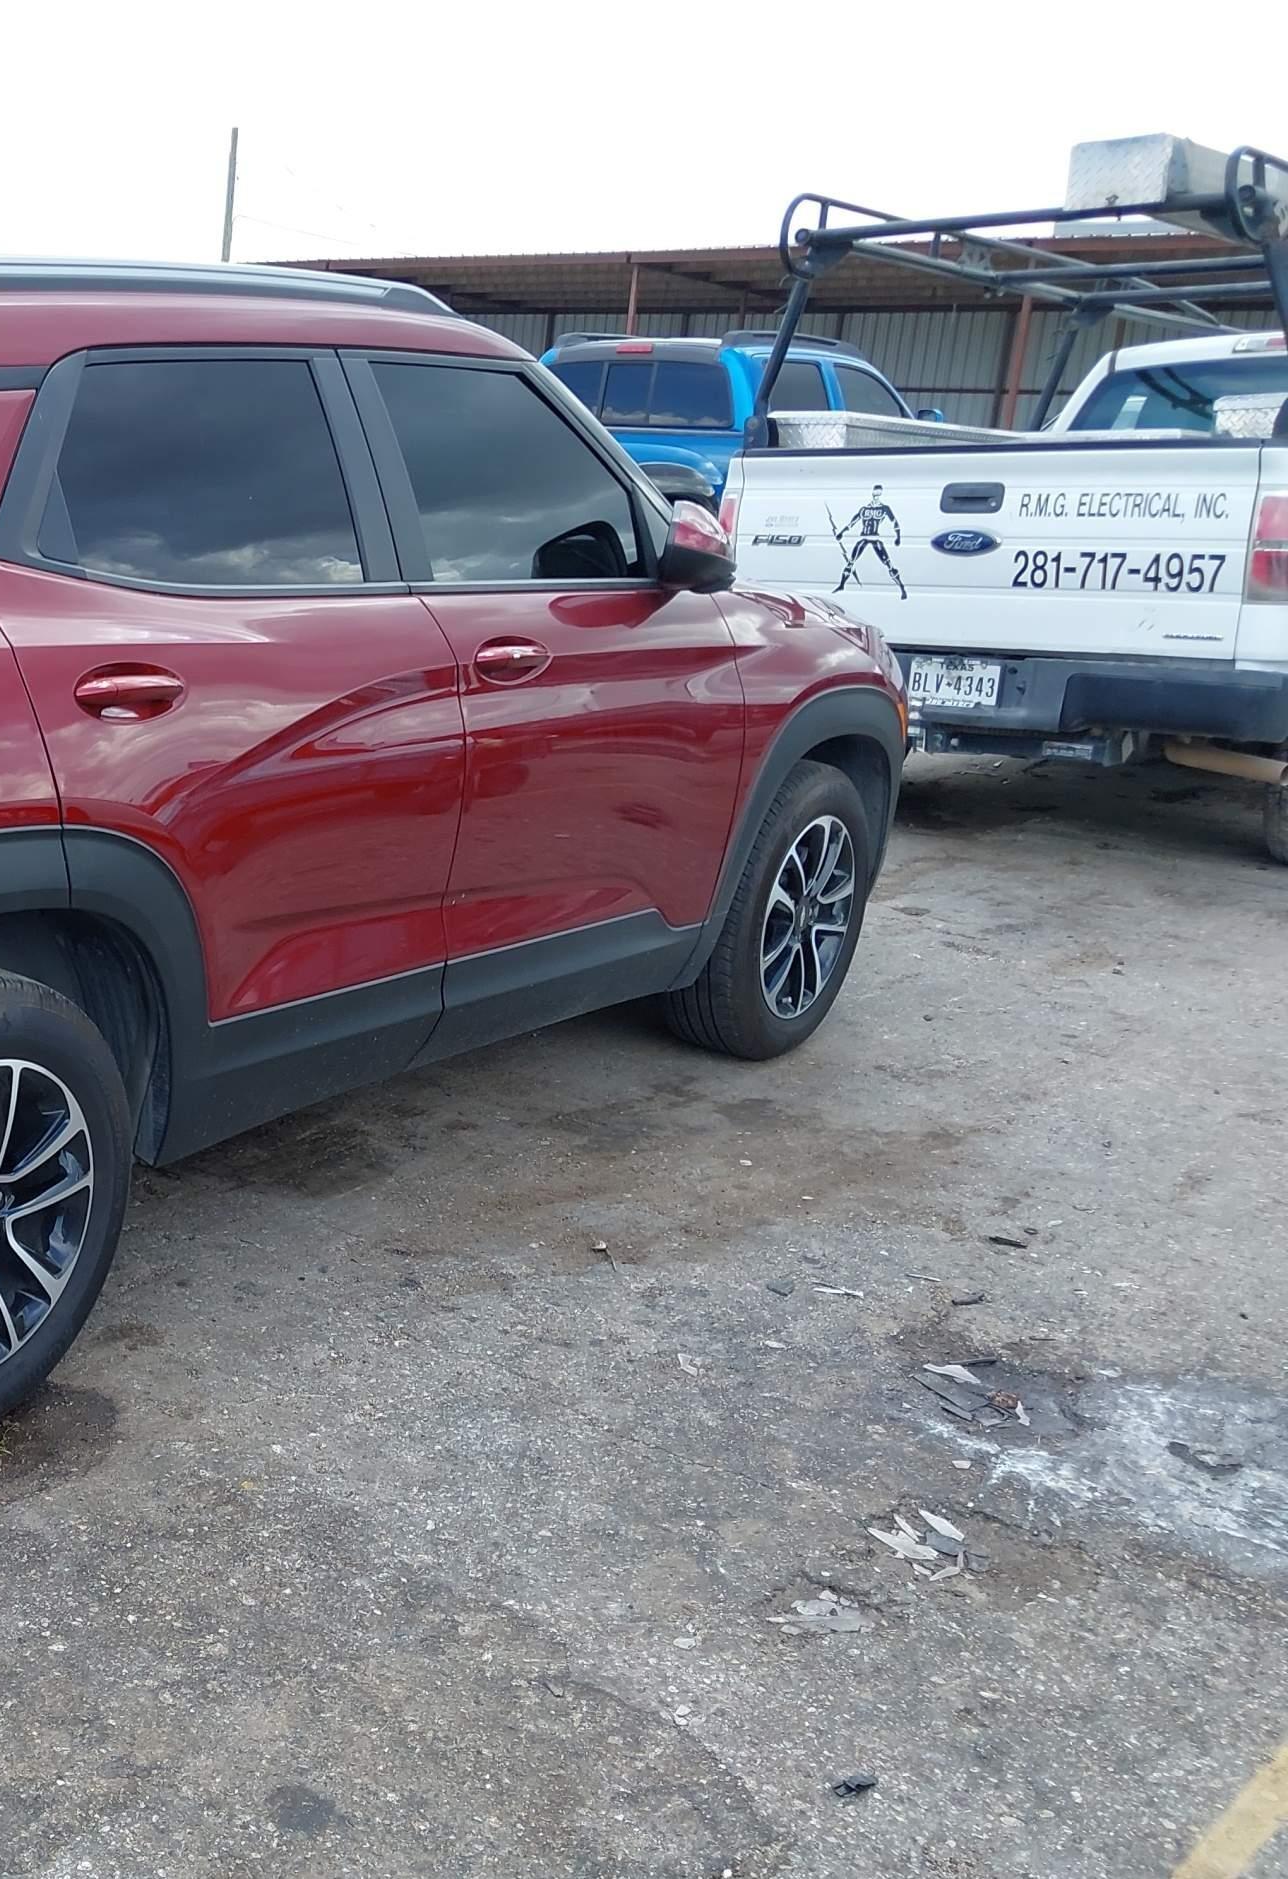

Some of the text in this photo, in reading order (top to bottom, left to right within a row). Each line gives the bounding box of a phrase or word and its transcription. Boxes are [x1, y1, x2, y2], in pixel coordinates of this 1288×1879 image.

[1018, 492, 1230, 523] R.M.G. ELECTRICAL, INC.
[943, 532, 984, 551] Ford
[1012, 549, 1227, 593] 281-717-4957
[940, 661, 975, 672] TEXAS
